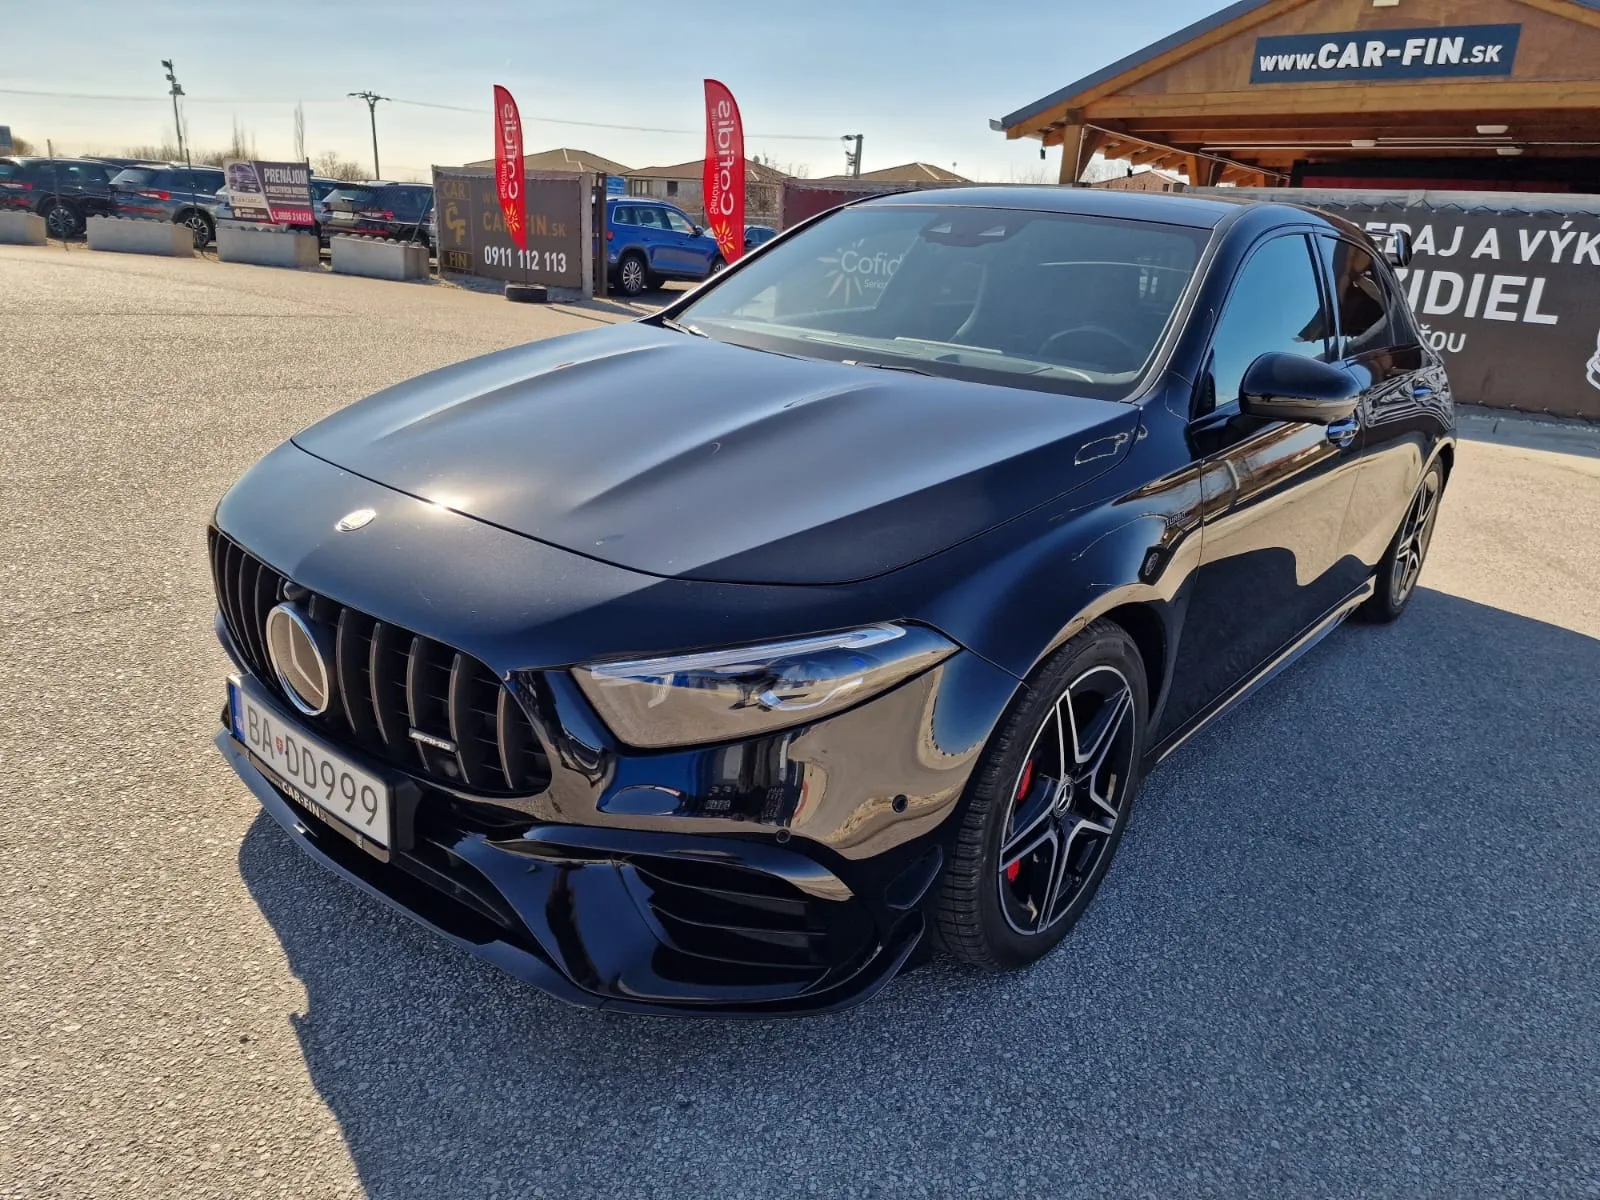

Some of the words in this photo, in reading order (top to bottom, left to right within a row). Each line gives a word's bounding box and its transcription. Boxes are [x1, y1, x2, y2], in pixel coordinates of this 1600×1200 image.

[263, 166, 308, 185] PRENÁJOM
[1471, 227, 1501, 260] A
[484, 245, 512, 267] 0911
[517, 249, 540, 271] 112
[544, 251, 567, 273] 113
[247, 704, 275, 760] BA
[285, 734, 378, 827] DD999
